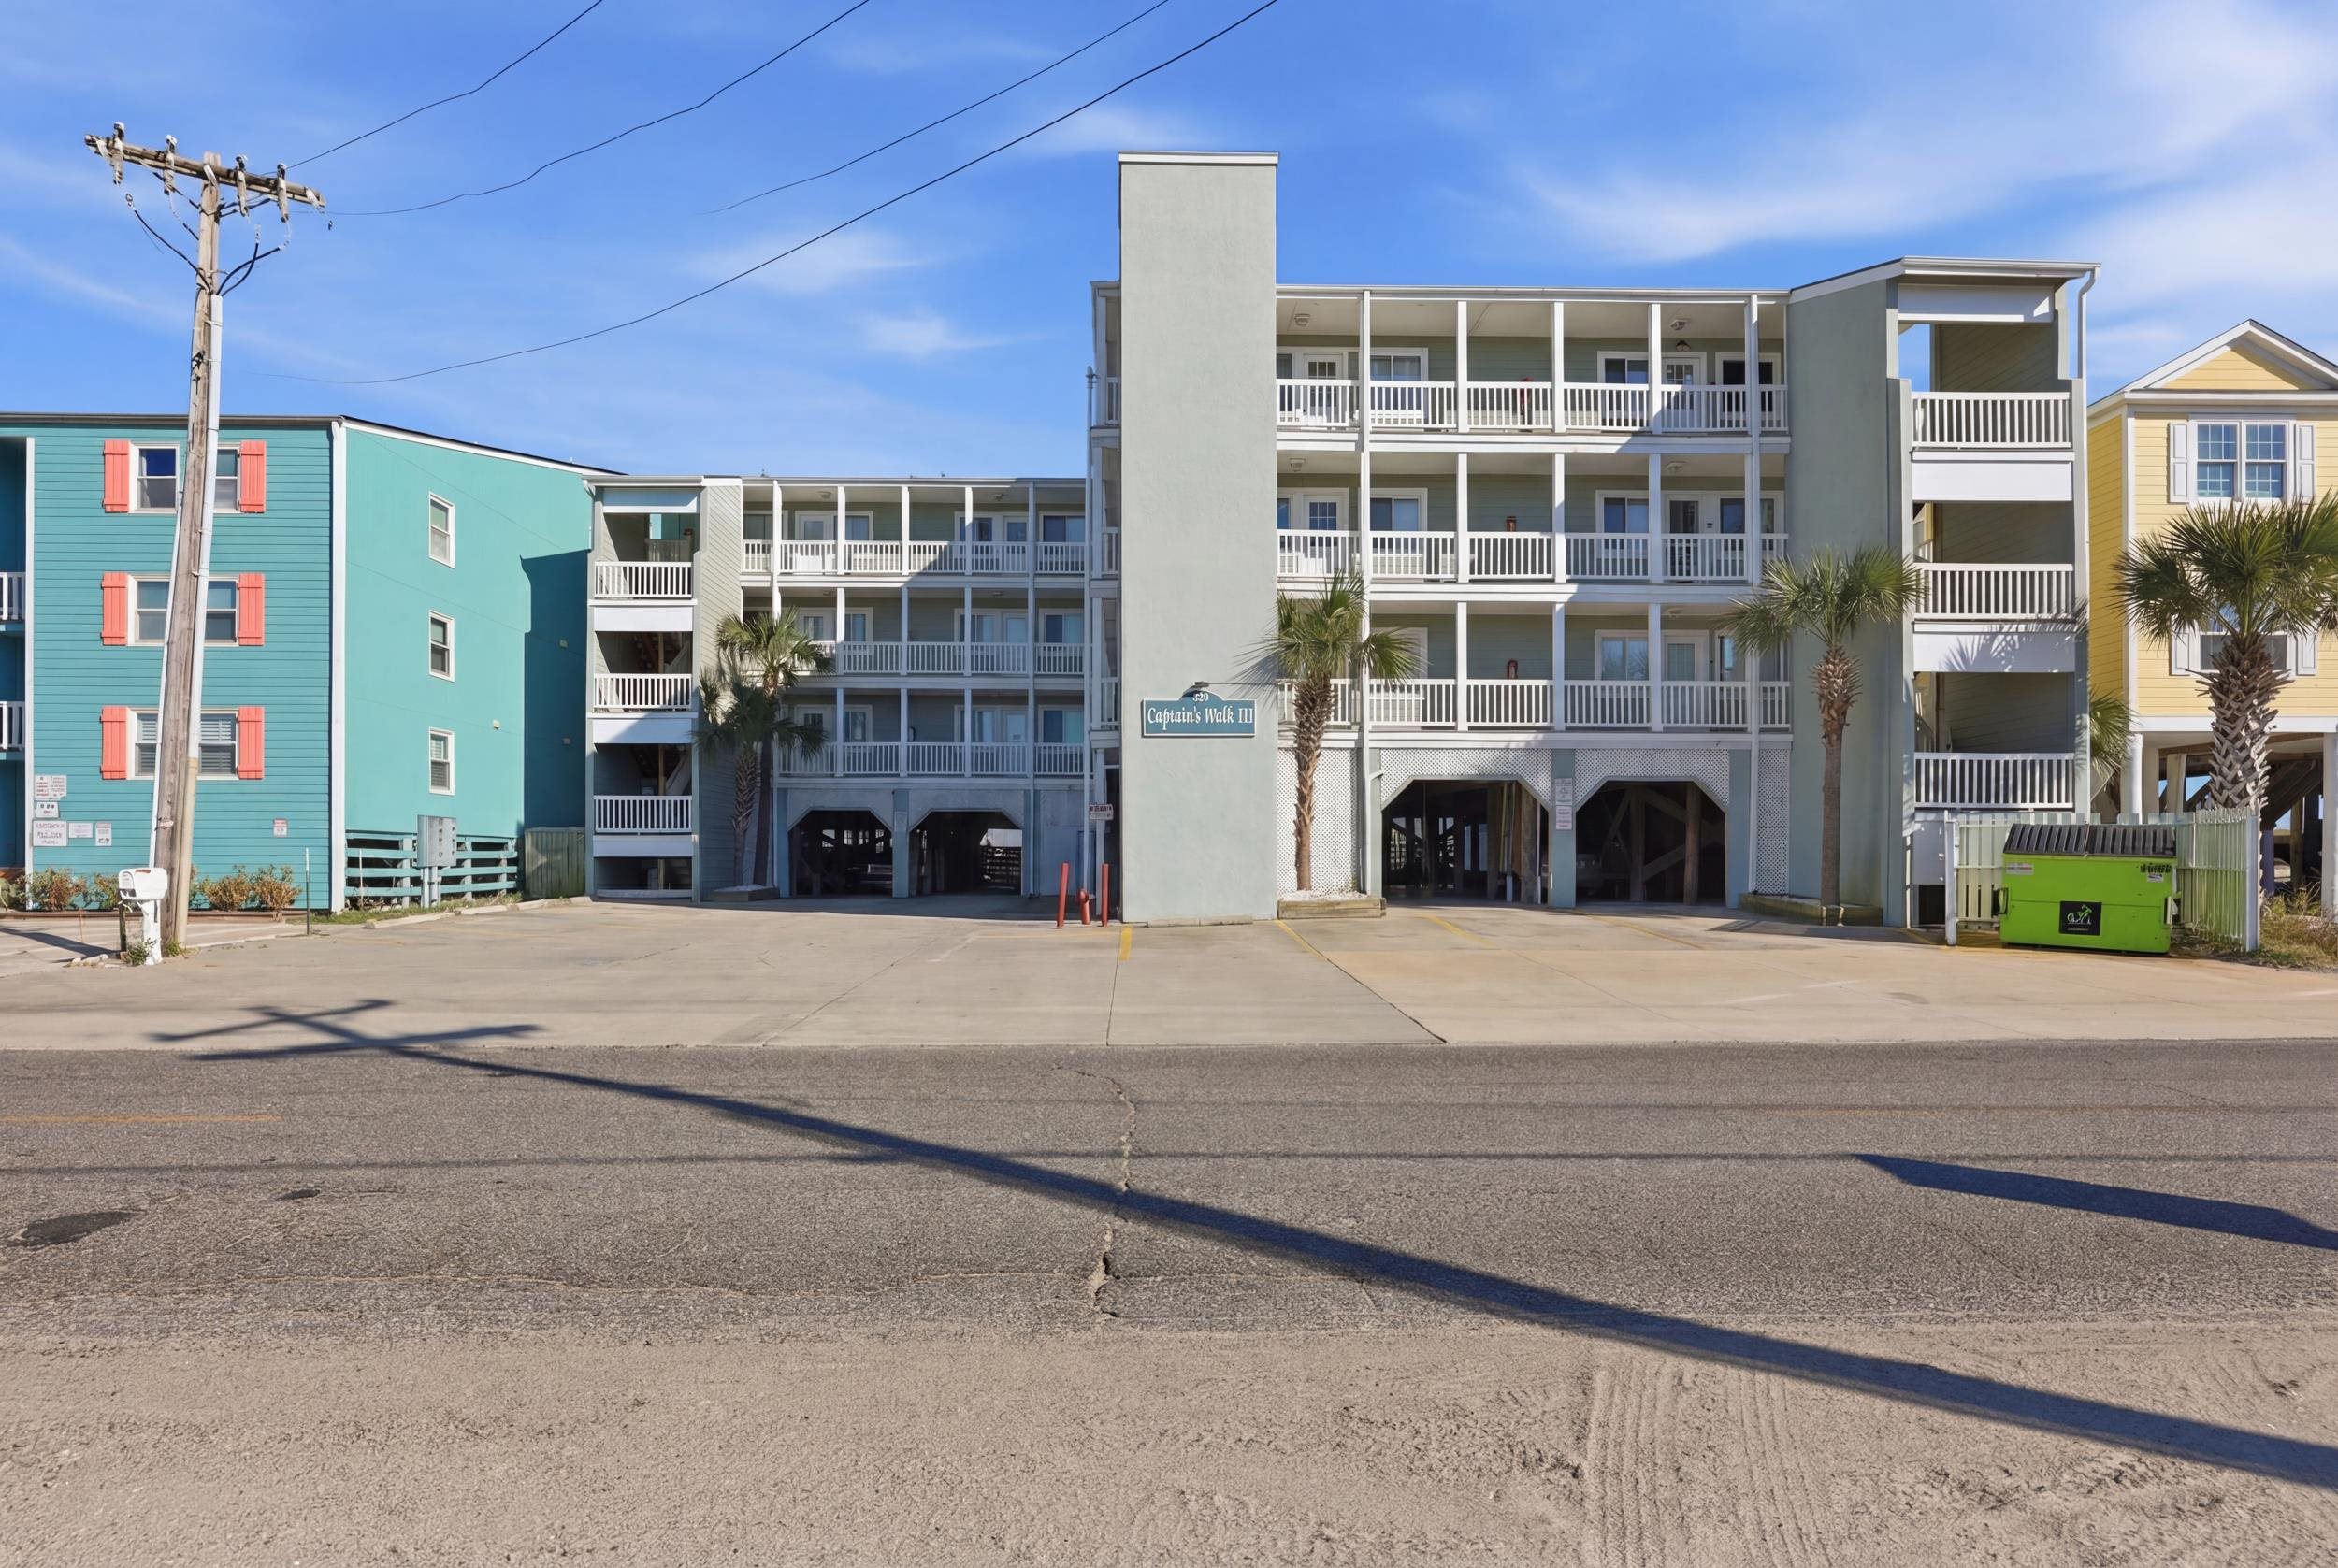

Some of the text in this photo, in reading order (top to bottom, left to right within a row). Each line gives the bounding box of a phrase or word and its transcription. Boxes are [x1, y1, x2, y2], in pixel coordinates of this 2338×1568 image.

[1147, 705, 1254, 730] Captain's Walk III
